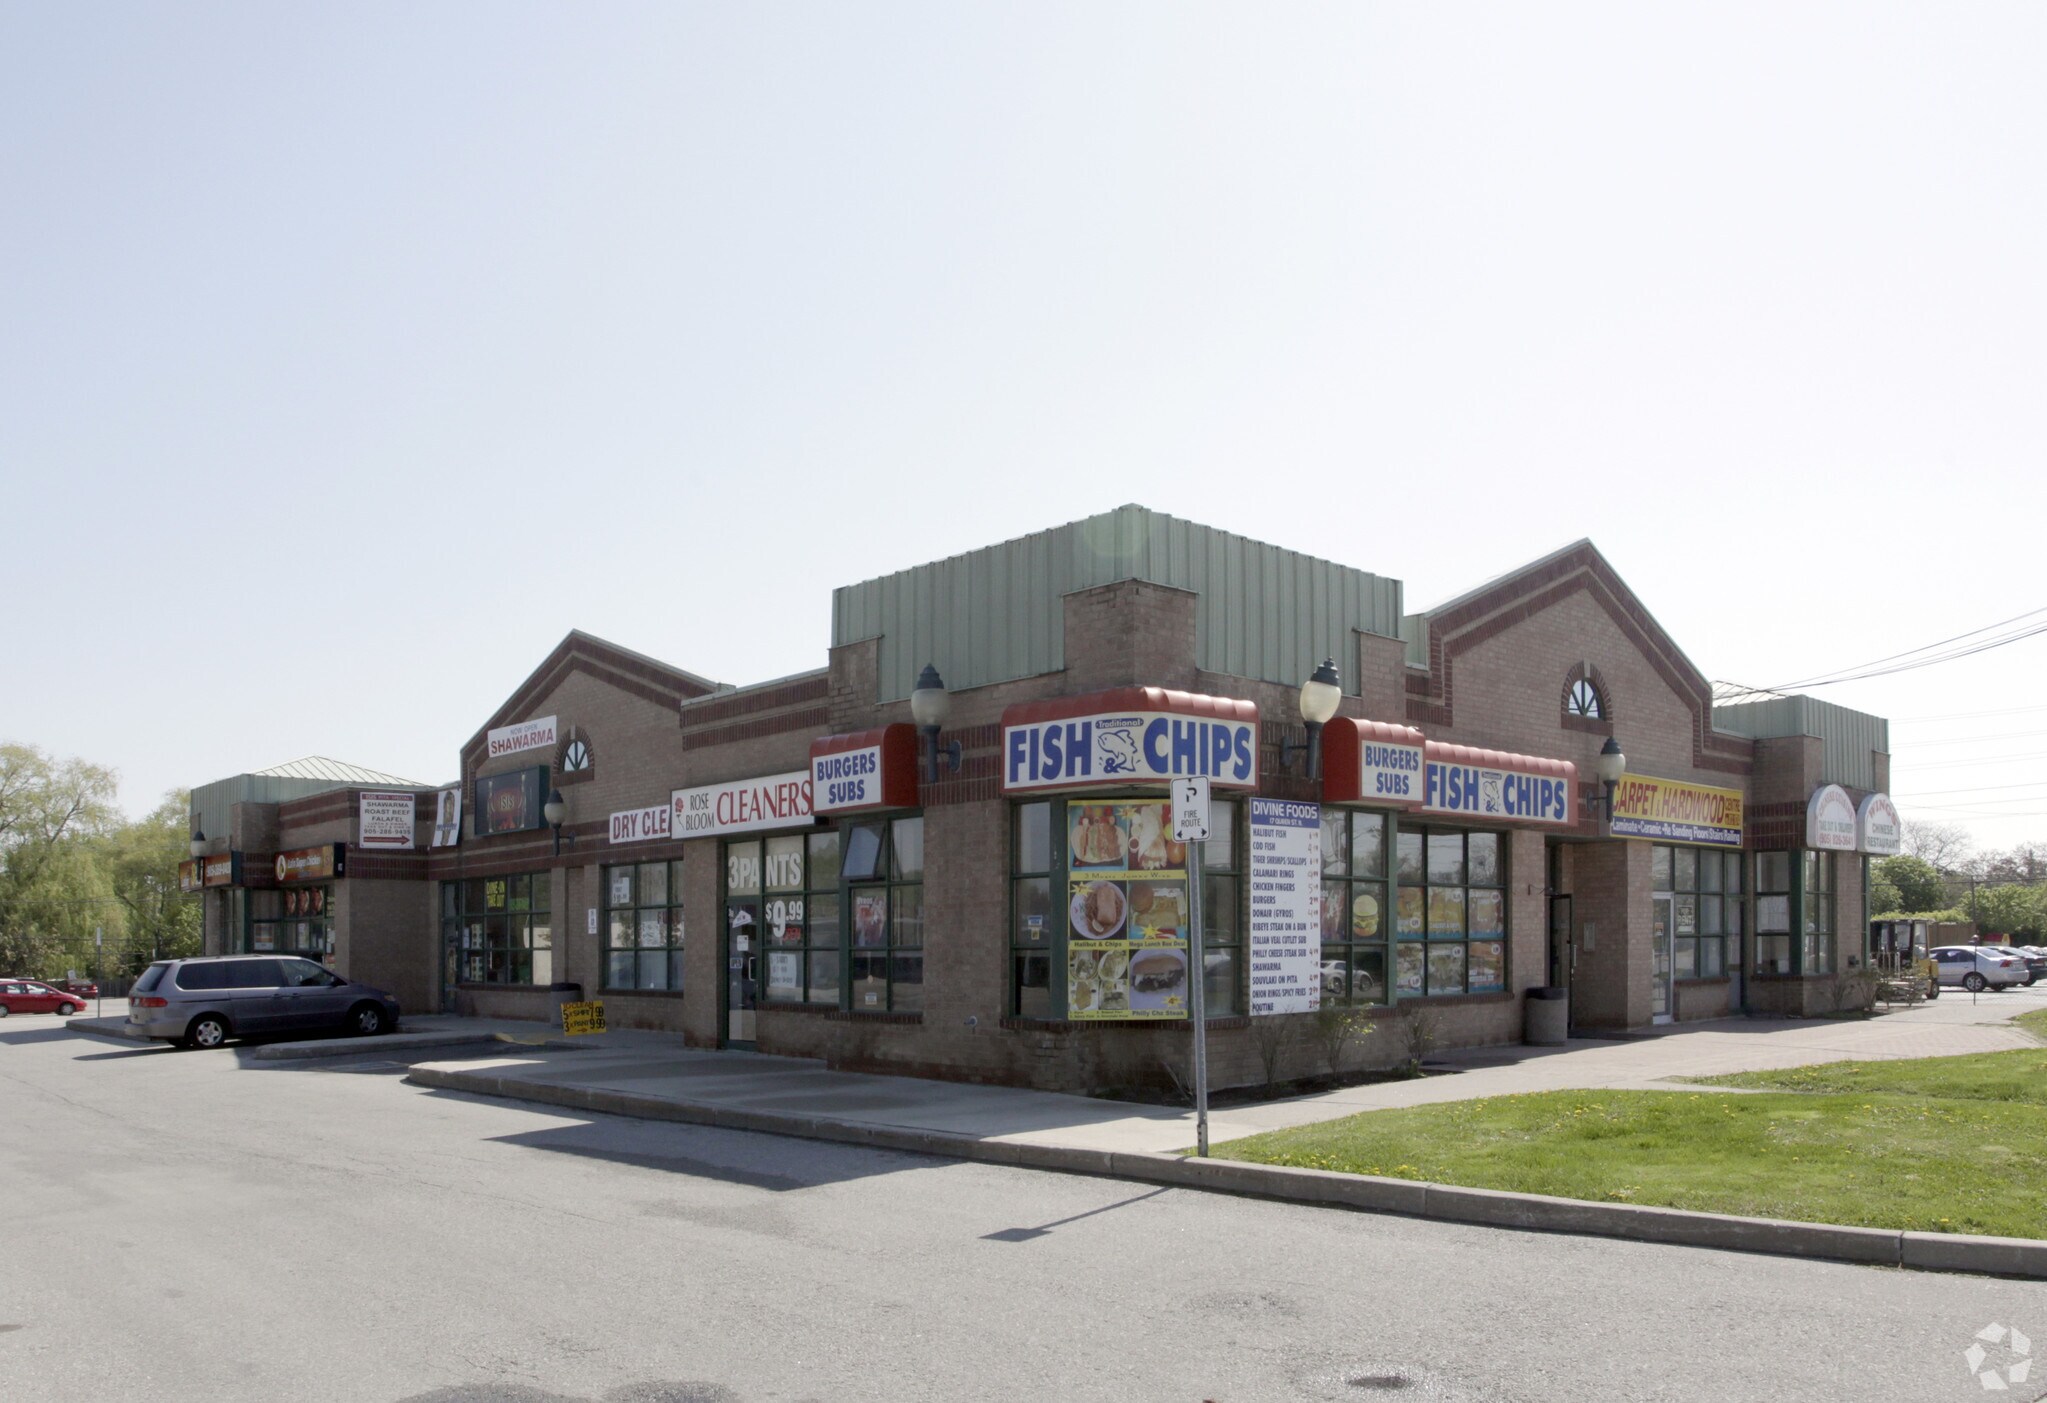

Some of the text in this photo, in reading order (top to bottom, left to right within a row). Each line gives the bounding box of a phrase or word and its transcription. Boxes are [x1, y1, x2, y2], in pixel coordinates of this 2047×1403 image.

[1099, 718, 1141, 729] Traditional
[510, 723, 538, 736] NOW OPEN
[490, 728, 554, 755] SHAWARMA
[1009, 717, 1252, 783] FISH & CHIPS
[1365, 745, 1419, 772] BURGERS
[817, 752, 876, 781] BURGERS
[1376, 772, 1409, 796] SUBS
[828, 779, 865, 804] SUBS
[1426, 763, 1479, 811] FISH
[1503, 773, 1565, 820] CHIPS
[690, 793, 709, 811] ROSE
[716, 780, 811, 826] CLEANERS
[1662, 787, 1724, 824] HARDWOOD
[1184, 809, 1198, 819] FIRE
[1252, 801, 1318, 819] DIVINE FOODS
[613, 813, 638, 840] DRY
[685, 812, 715, 831] BLOOM
[1180, 818, 1202, 828] ROUTE
[1252, 828, 1287, 839] HALIBUT FISH
[1871, 823, 1894, 835] CHINESE
[1252, 841, 1276, 851] COD FISH
[1867, 836, 1899, 849] RESTAURANT
[1252, 855, 1266, 864] TIGER
[1252, 868, 1295, 879] CALAMARI RINGS
[1252, 882, 1295, 892] CHICKEN FINGERS
[1252, 896, 1275, 904] BURGERS
[1252, 909, 1294, 919] DONAIR (GYROS)
[1252, 922, 1269, 931] RIBEYE
[1270, 922, 1284, 931] STEAK
[1284, 922, 1291, 931] ON
[1292, 922, 1296, 931] A
[1297, 922, 1307, 931] BUN
[1105, 941, 1122, 949] Chips
[1252, 935, 1307, 945] ITALIAN VEAL CUTLET SUB
[1252, 949, 1268, 958] PHILLY
[1268, 949, 1283, 957] CHEESE
[1284, 949, 1297, 957] STEAK
[1298, 948, 1307, 957] SUB
[1252, 963, 1281, 971] SHAWARMA
[1252, 975, 1298, 985] SOUVLAKI ON PITA
[1252, 990, 1267, 998] ONION
[1267, 989, 1281, 998] RINGS
[1294, 987, 1306, 996] FRIES
[1252, 1002, 1274, 1012] POUTINE
[563, 1009, 569, 1020] 5
[1132, 1010, 1151, 1018] Philly
[564, 1020, 569, 1032] 3
